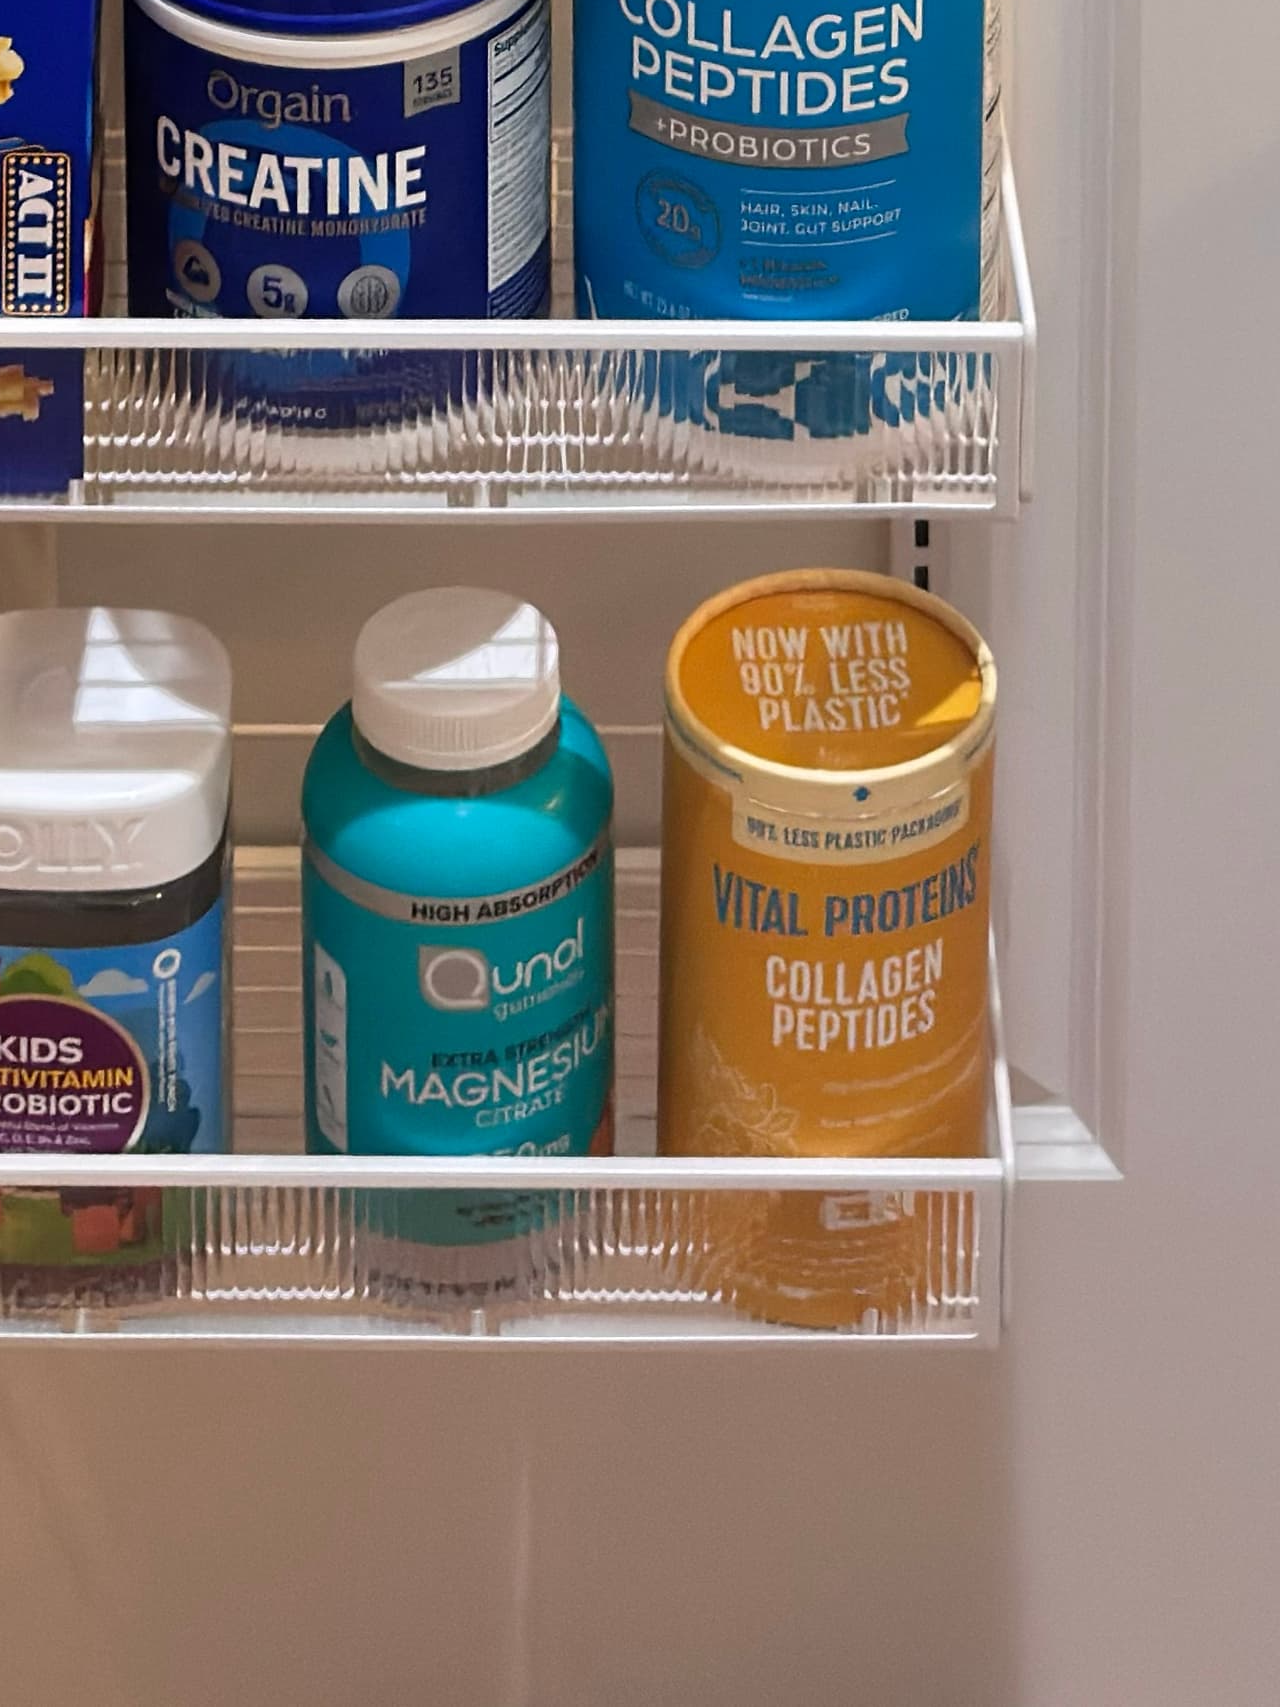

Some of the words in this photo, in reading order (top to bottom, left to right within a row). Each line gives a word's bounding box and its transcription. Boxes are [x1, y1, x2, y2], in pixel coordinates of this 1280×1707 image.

[207, 69, 352, 129] Orgain
[413, 67, 453, 94] 135
[632, 36, 910, 116] PEPTIDES
[157, 114, 426, 216] CREATINE
[657, 116, 871, 161] +PROBIOTICS
[18, 169, 54, 249] ACT
[234, 211, 306, 236] CREATINE
[311, 207, 426, 237] MONOHYDRATE
[740, 200, 784, 217] HAIR,
[791, 202, 832, 217] SKIN,
[795, 221, 826, 235] GUT
[832, 208, 902, 233] SUPPORT
[18, 254, 53, 299] II
[732, 627, 808, 661] NOW
[820, 621, 908, 656] WITH
[740, 662, 815, 696] 90%
[830, 657, 911, 695] LESS
[411, 903, 470, 922] HIGH
[476, 850, 598, 920] ABSORPTION
[713, 863, 809, 936] VITAL
[825, 844, 978, 937] PROTEINS
[424, 917, 584, 1008] Qunol
[766, 938, 944, 1006] COLLAGEN
[773, 989, 936, 1052] PEPTIDES
[380, 1003, 609, 1108] MAGNESIUM
[476, 1084, 565, 1127] CITRATE
